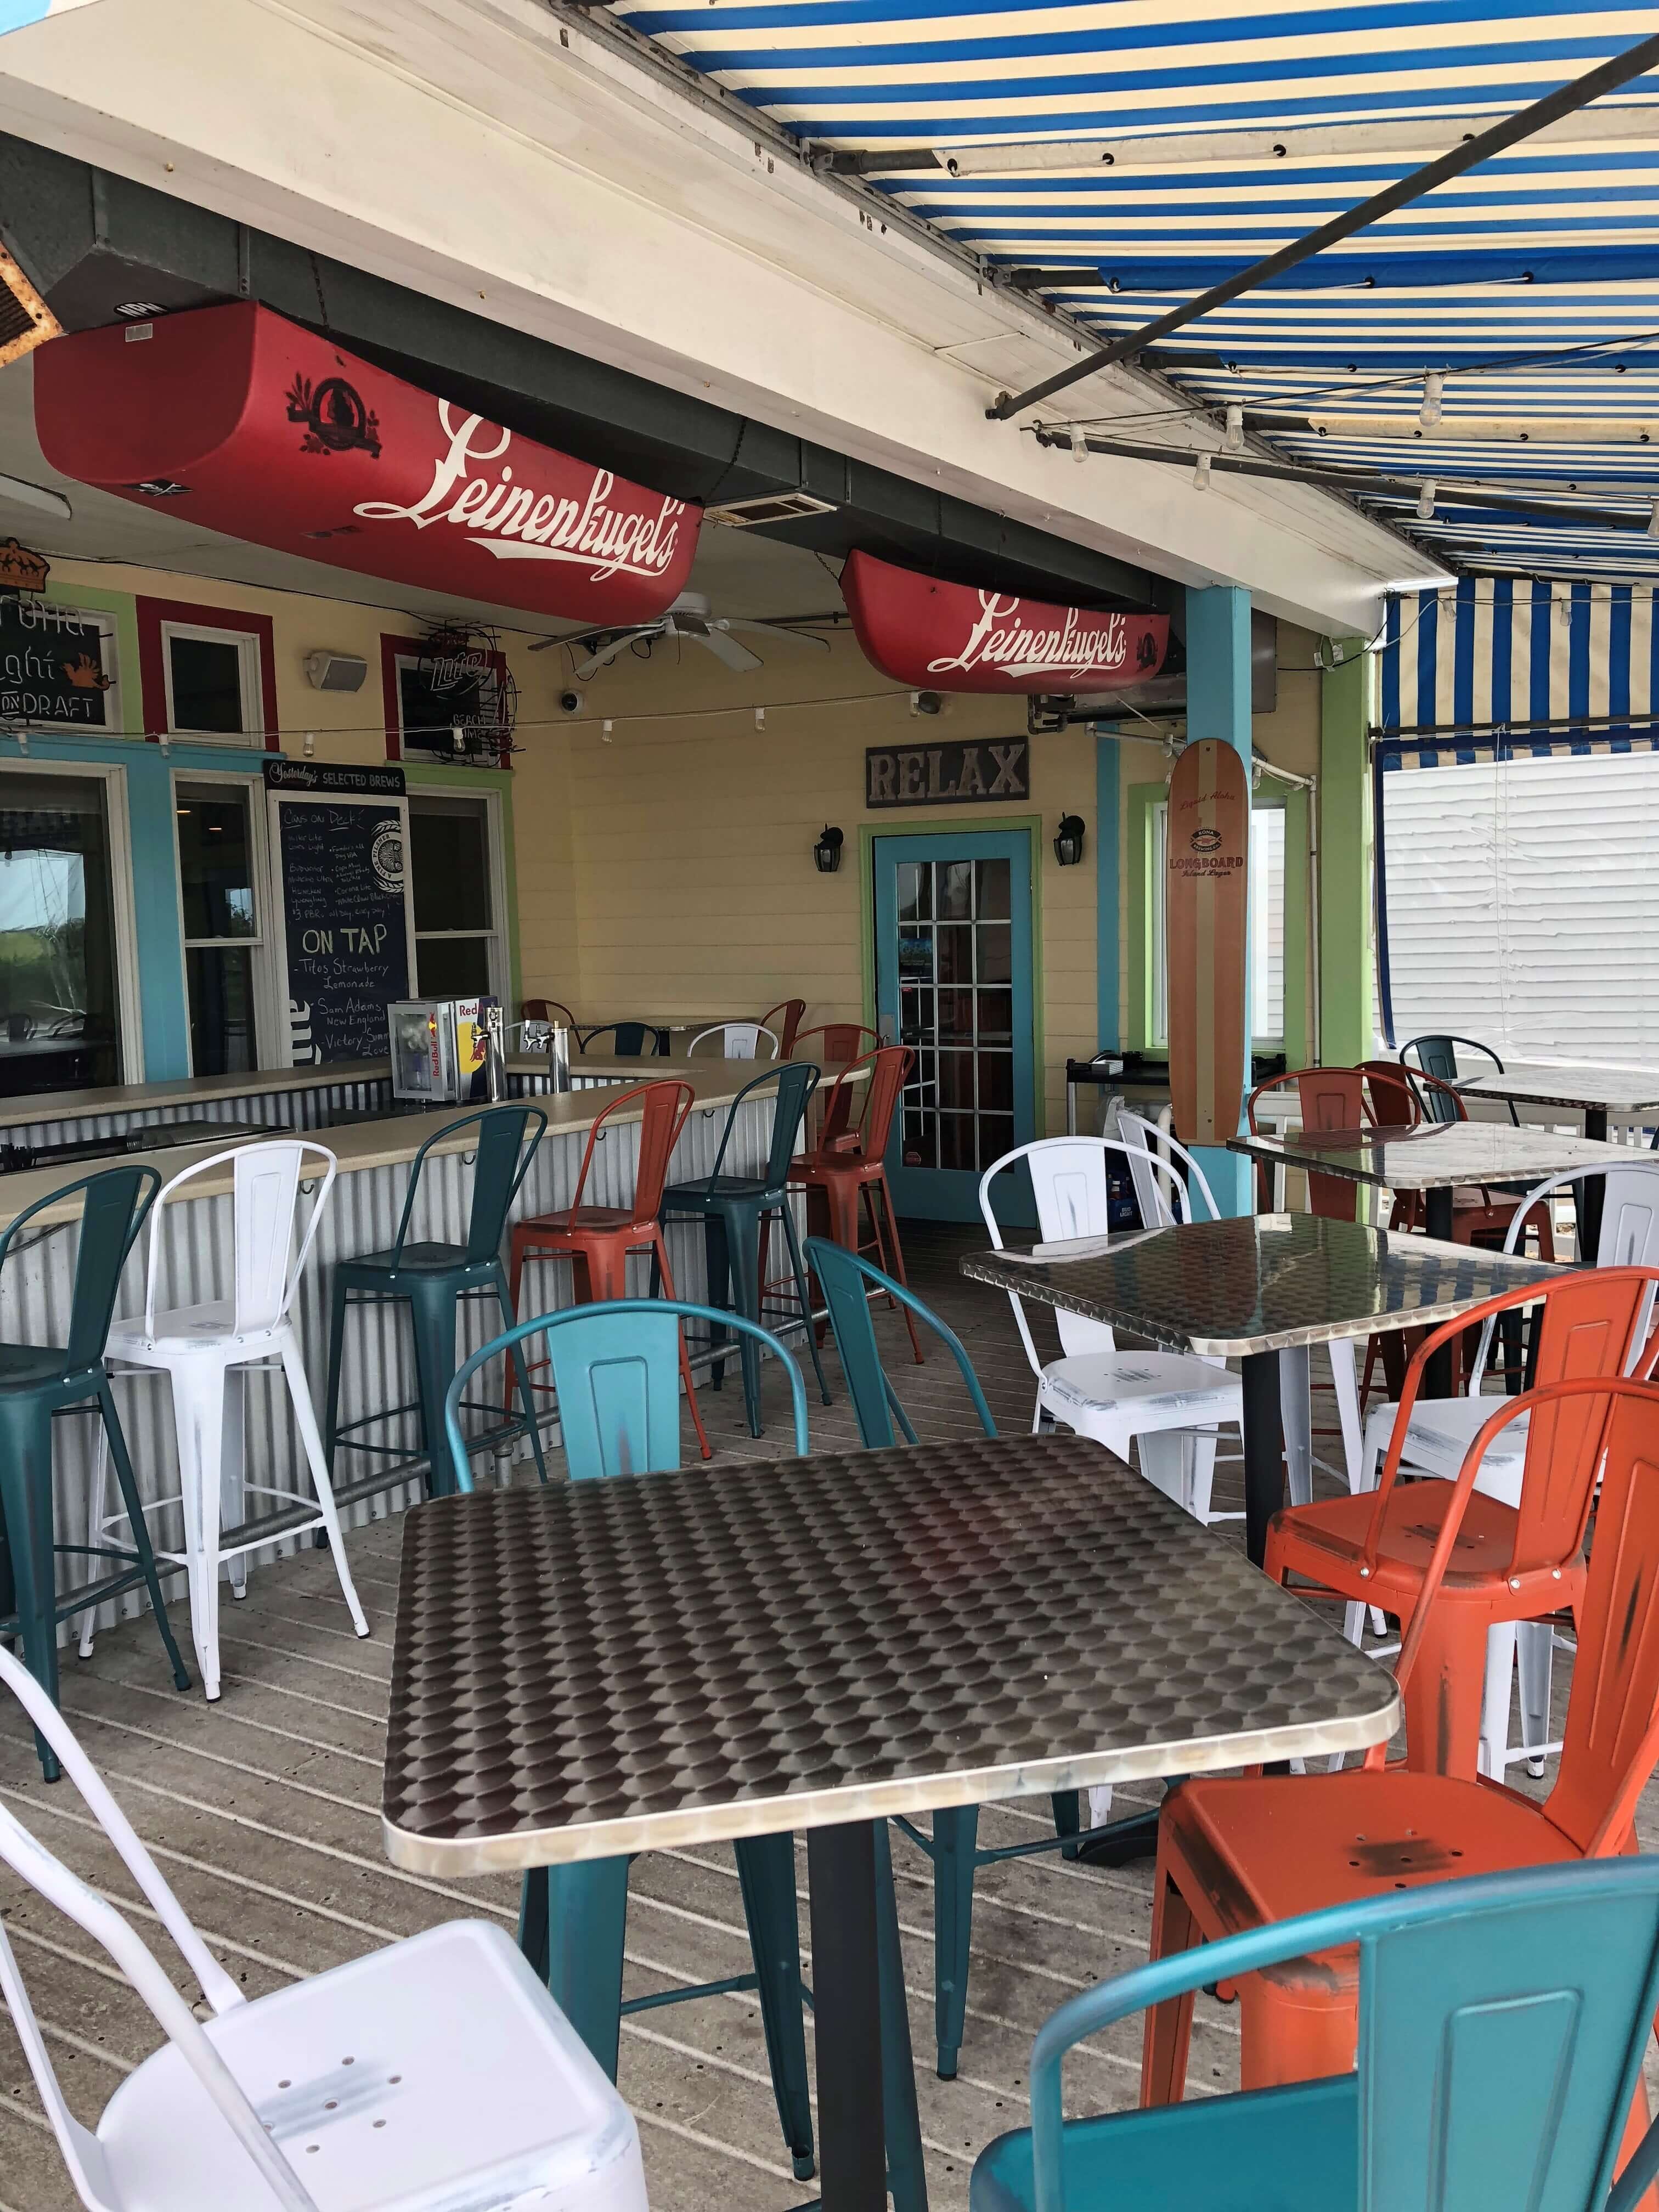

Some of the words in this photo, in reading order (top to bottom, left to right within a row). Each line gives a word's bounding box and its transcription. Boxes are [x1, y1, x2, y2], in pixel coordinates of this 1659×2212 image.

[353, 397, 679, 582] Leinenkugel's
[927, 589, 1127, 679] Leinenkugel's
[0, 646, 55, 684] ght
[430, 652, 483, 692] Lite
[22, 693, 94, 718] DRAFT
[269, 762, 318, 787] Yesterday's
[323, 772, 366, 786] SELECTED
[369, 774, 401, 788] BREWS
[869, 743, 1025, 802] RELAX
[1209, 791, 1235, 800] Aloha
[373, 833, 391, 857] PILSNER
[302, 929, 333, 954] ON
[340, 924, 387, 955] TAP
[298, 958, 329, 974] Titos
[334, 957, 389, 977] Strawberry
[323, 975, 376, 990] Lemonade
[318, 997, 343, 1014] Sam
[346, 997, 381, 1013] Adams
[459, 1003, 477, 1016] Red
[349, 1010, 386, 1034] England
[325, 1033, 363, 1051] Victory
[362, 1044, 390, 1056] Love
[431, 1041, 439, 1058] Bull
[431, 1059, 439, 1076] Red
